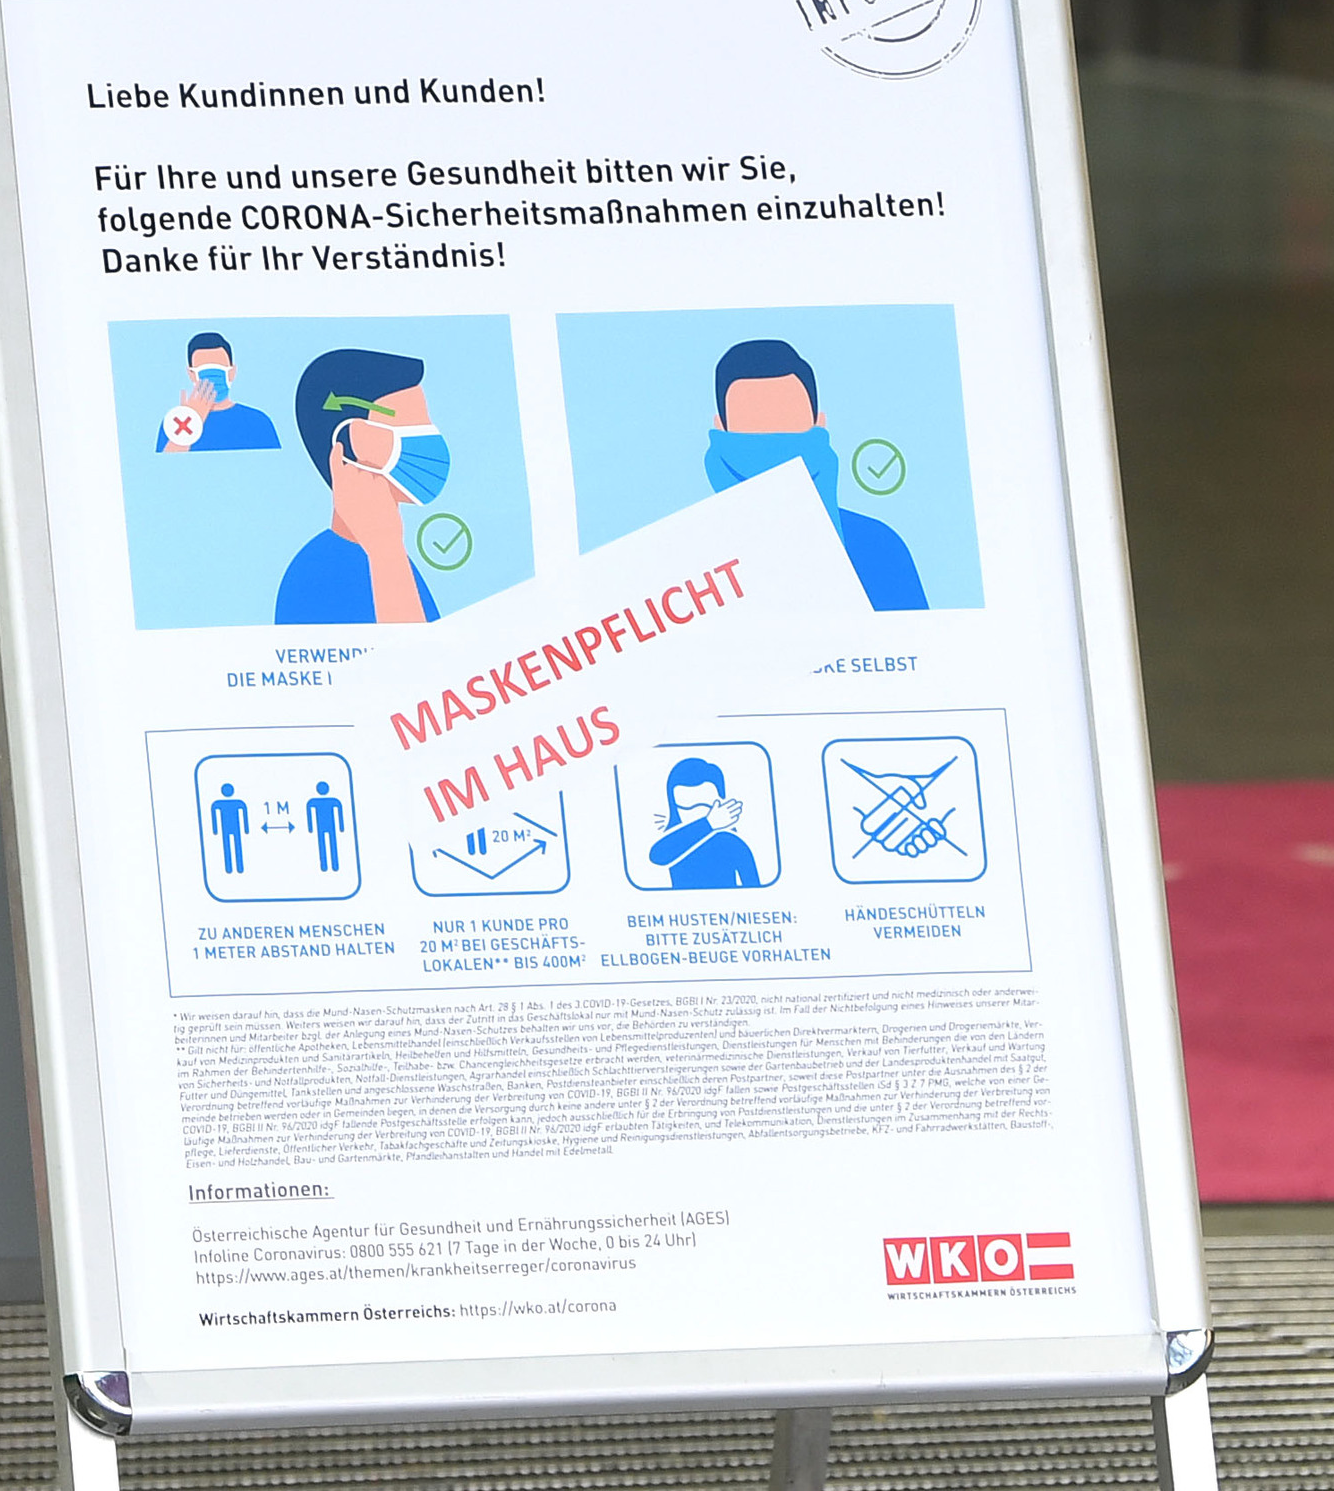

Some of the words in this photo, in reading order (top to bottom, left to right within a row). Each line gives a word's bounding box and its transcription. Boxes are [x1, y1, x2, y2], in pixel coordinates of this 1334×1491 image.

[86, 82, 169, 108] Liebe
[178, 81, 344, 108] Kundinnen
[353, 77, 410, 104] und
[419, 76, 544, 103] Kunden!
[94, 163, 147, 191] Für
[156, 163, 217, 189] Ihre
[226, 163, 281, 189] und
[291, 167, 397, 189] unsere
[406, 158, 577, 186] Gesundheit
[585, 157, 673, 184] bitten
[680, 155, 730, 182] wir
[739, 154, 795, 184] Sie,
[97, 204, 232, 238] folgende
[240, 197, 747, 230] CORONA-Sicherheitsmaßnahmen
[756, 190, 944, 221] einzuhalten!
[101, 246, 198, 274] Danke
[207, 244, 252, 271] für
[261, 245, 304, 271] Ihr
[310, 241, 505, 270] Verständnis!
[390, 558, 745, 751] MASKENPFLICHT
[851, 656, 917, 672] SELBST
[226, 671, 256, 687] DIE
[260, 669, 323, 686] MASKE
[424, 766, 490, 823] IM
[494, 706, 621, 790] HAUS
[263, 800, 270, 815] 1
[276, 800, 289, 815] M
[492, 829, 509, 844] 20
[626, 913, 665, 928] BEIM
[668, 910, 797, 929] HUSTEN/NIESEN:
[844, 902, 985, 921] HÄNDESCHÜTTELN
[197, 926, 217, 941] ZU
[221, 924, 294, 940] ANDEREN
[298, 922, 385, 938] MENSCHEN
[432, 919, 465, 934] NUR
[469, 919, 476, 932] 1
[481, 917, 534, 932] KUNDE
[537, 916, 569, 935] PRO
[872, 924, 961, 939] VERMEIDEN
[460, 937, 486, 952] BEI
[489, 933, 585, 951] GESCHÄFTS-
[644, 931, 688, 946] BITTE
[691, 927, 782, 945] ZUSÄTZLICH
[192, 946, 199, 960] 1
[203, 944, 256, 959] METER
[260, 942, 331, 958] ABSTAND
[334, 940, 395, 956] HALTEN
[600, 949, 738, 967] ELLBOGEN-BEUGE
[741, 947, 831, 962] VORHALTEN
[188, 1180, 330, 1201] Informationen:
[191, 1224, 308, 1243] Österreichische
[311, 1224, 370, 1242] Agentur
[373, 1222, 395, 1236] für
[398, 1219, 481, 1236] Gesundheit
[485, 1217, 513, 1233] und
[517, 1212, 677, 1233] Ernährungssicherheit
[680, 1209, 729, 1227] (AGES)
[193, 1248, 249, 1264] Infoline
[253, 1245, 346, 1261] Coronavirus:
[349, 1243, 384, 1258] 0800
[387, 1241, 414, 1257] 555
[417, 1241, 442, 1256] 621
[447, 1239, 460, 1256] (7
[464, 1239, 499, 1258] Tage
[503, 1238, 517, 1253] in
[520, 1237, 546, 1252] der
[548, 1236, 602, 1251] Woche,
[605, 1234, 614, 1249] 0
[617, 1234, 640, 1249] bis
[643, 1233, 661, 1248] 24
[664, 1230, 696, 1247] Uhr)
[884, 1237, 1021, 1281] WKO
[195, 1255, 636, 1287] https://www.ages.at/themen/krankheitserreger/coronavirus
[886, 1288, 1006, 1300] WIRTSCHAFTSKAMMERN
[1008, 1285, 1077, 1296] ÖSTERREICHS
[198, 1309, 359, 1326] Wirtschaftskammern
[362, 1304, 455, 1321] Österreichs:
[459, 1298, 616, 1319] https://wko.at/corona
